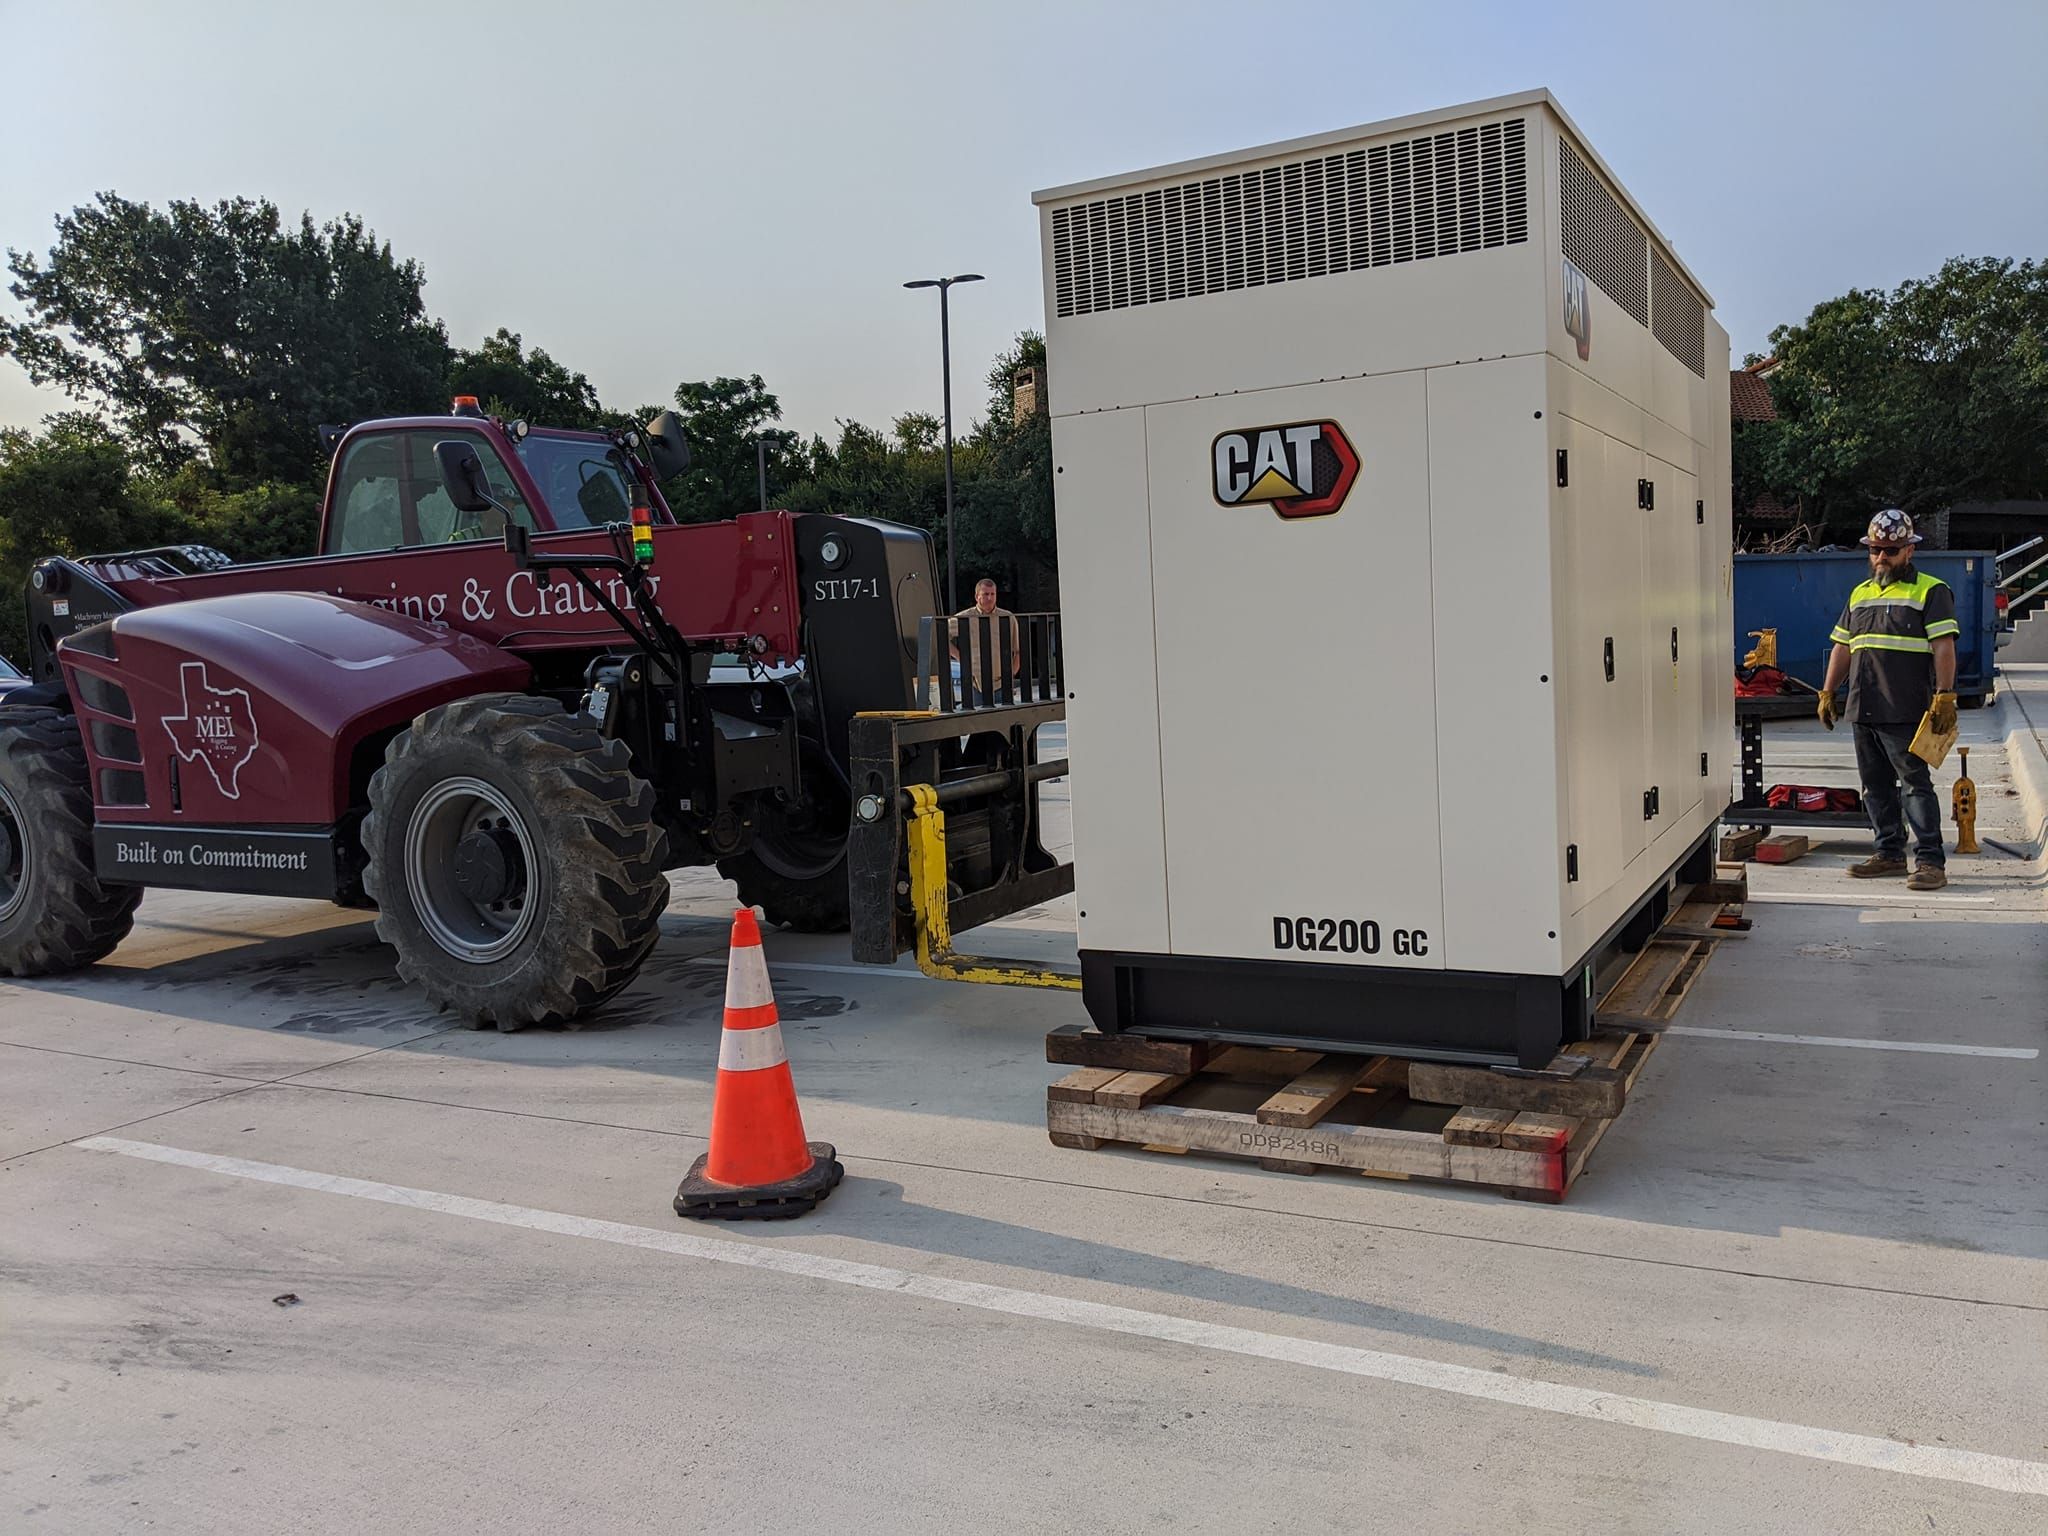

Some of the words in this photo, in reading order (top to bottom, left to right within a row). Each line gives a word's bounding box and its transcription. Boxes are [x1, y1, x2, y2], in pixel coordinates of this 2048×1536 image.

[1564, 263, 1585, 339] CAT
[1214, 423, 1321, 503] CAT
[461, 577, 495, 622] &
[814, 577, 880, 601] ST17-1
[195, 716, 236, 738] MEI
[116, 841, 157, 863] Built
[163, 848, 184, 865] on
[190, 844, 307, 870] Commitment
[1273, 916, 1381, 954] DG200
[1393, 929, 1429, 957] GC
